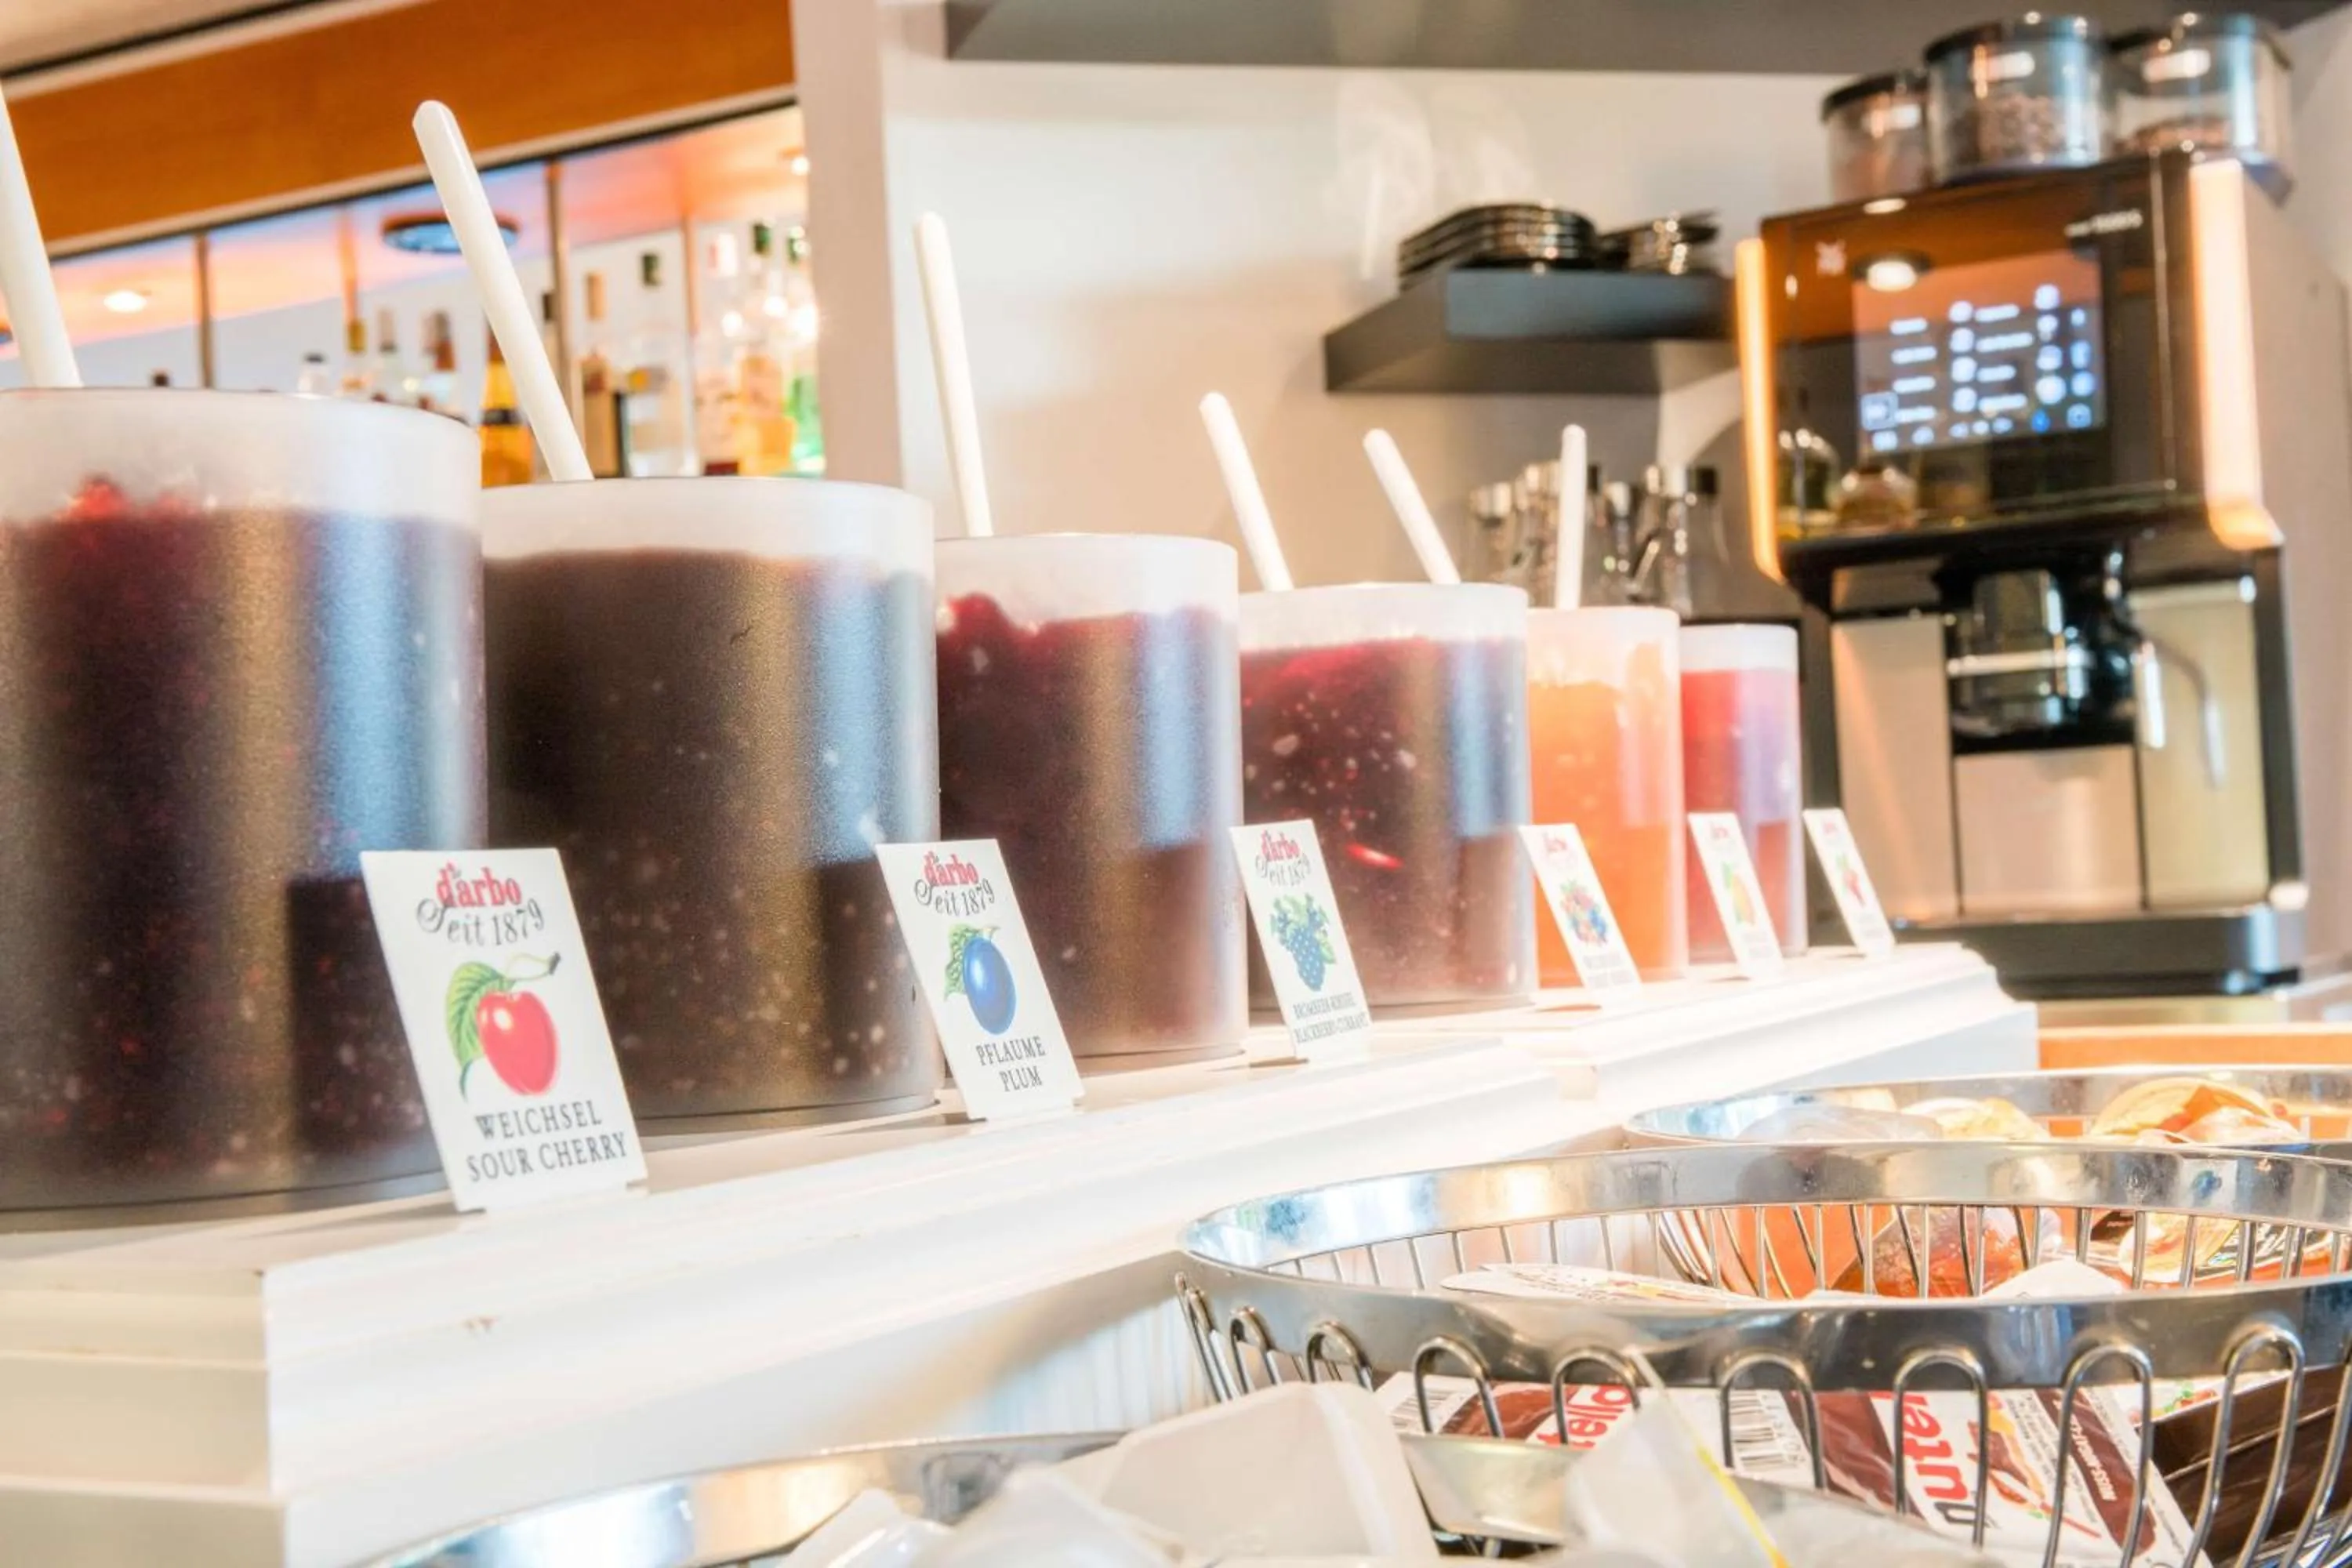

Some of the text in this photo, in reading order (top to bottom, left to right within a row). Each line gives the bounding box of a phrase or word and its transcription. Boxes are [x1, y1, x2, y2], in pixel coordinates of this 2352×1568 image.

[914, 877, 995, 916] Seit 1879
[416, 898, 544, 946] Seit 1879
[975, 1035, 1046, 1066] PFLAUME
[999, 1066, 1043, 1092] PLUM
[474, 1100, 602, 1139] WEICHSEL
[466, 1131, 627, 1182] SOUR CHERRY
